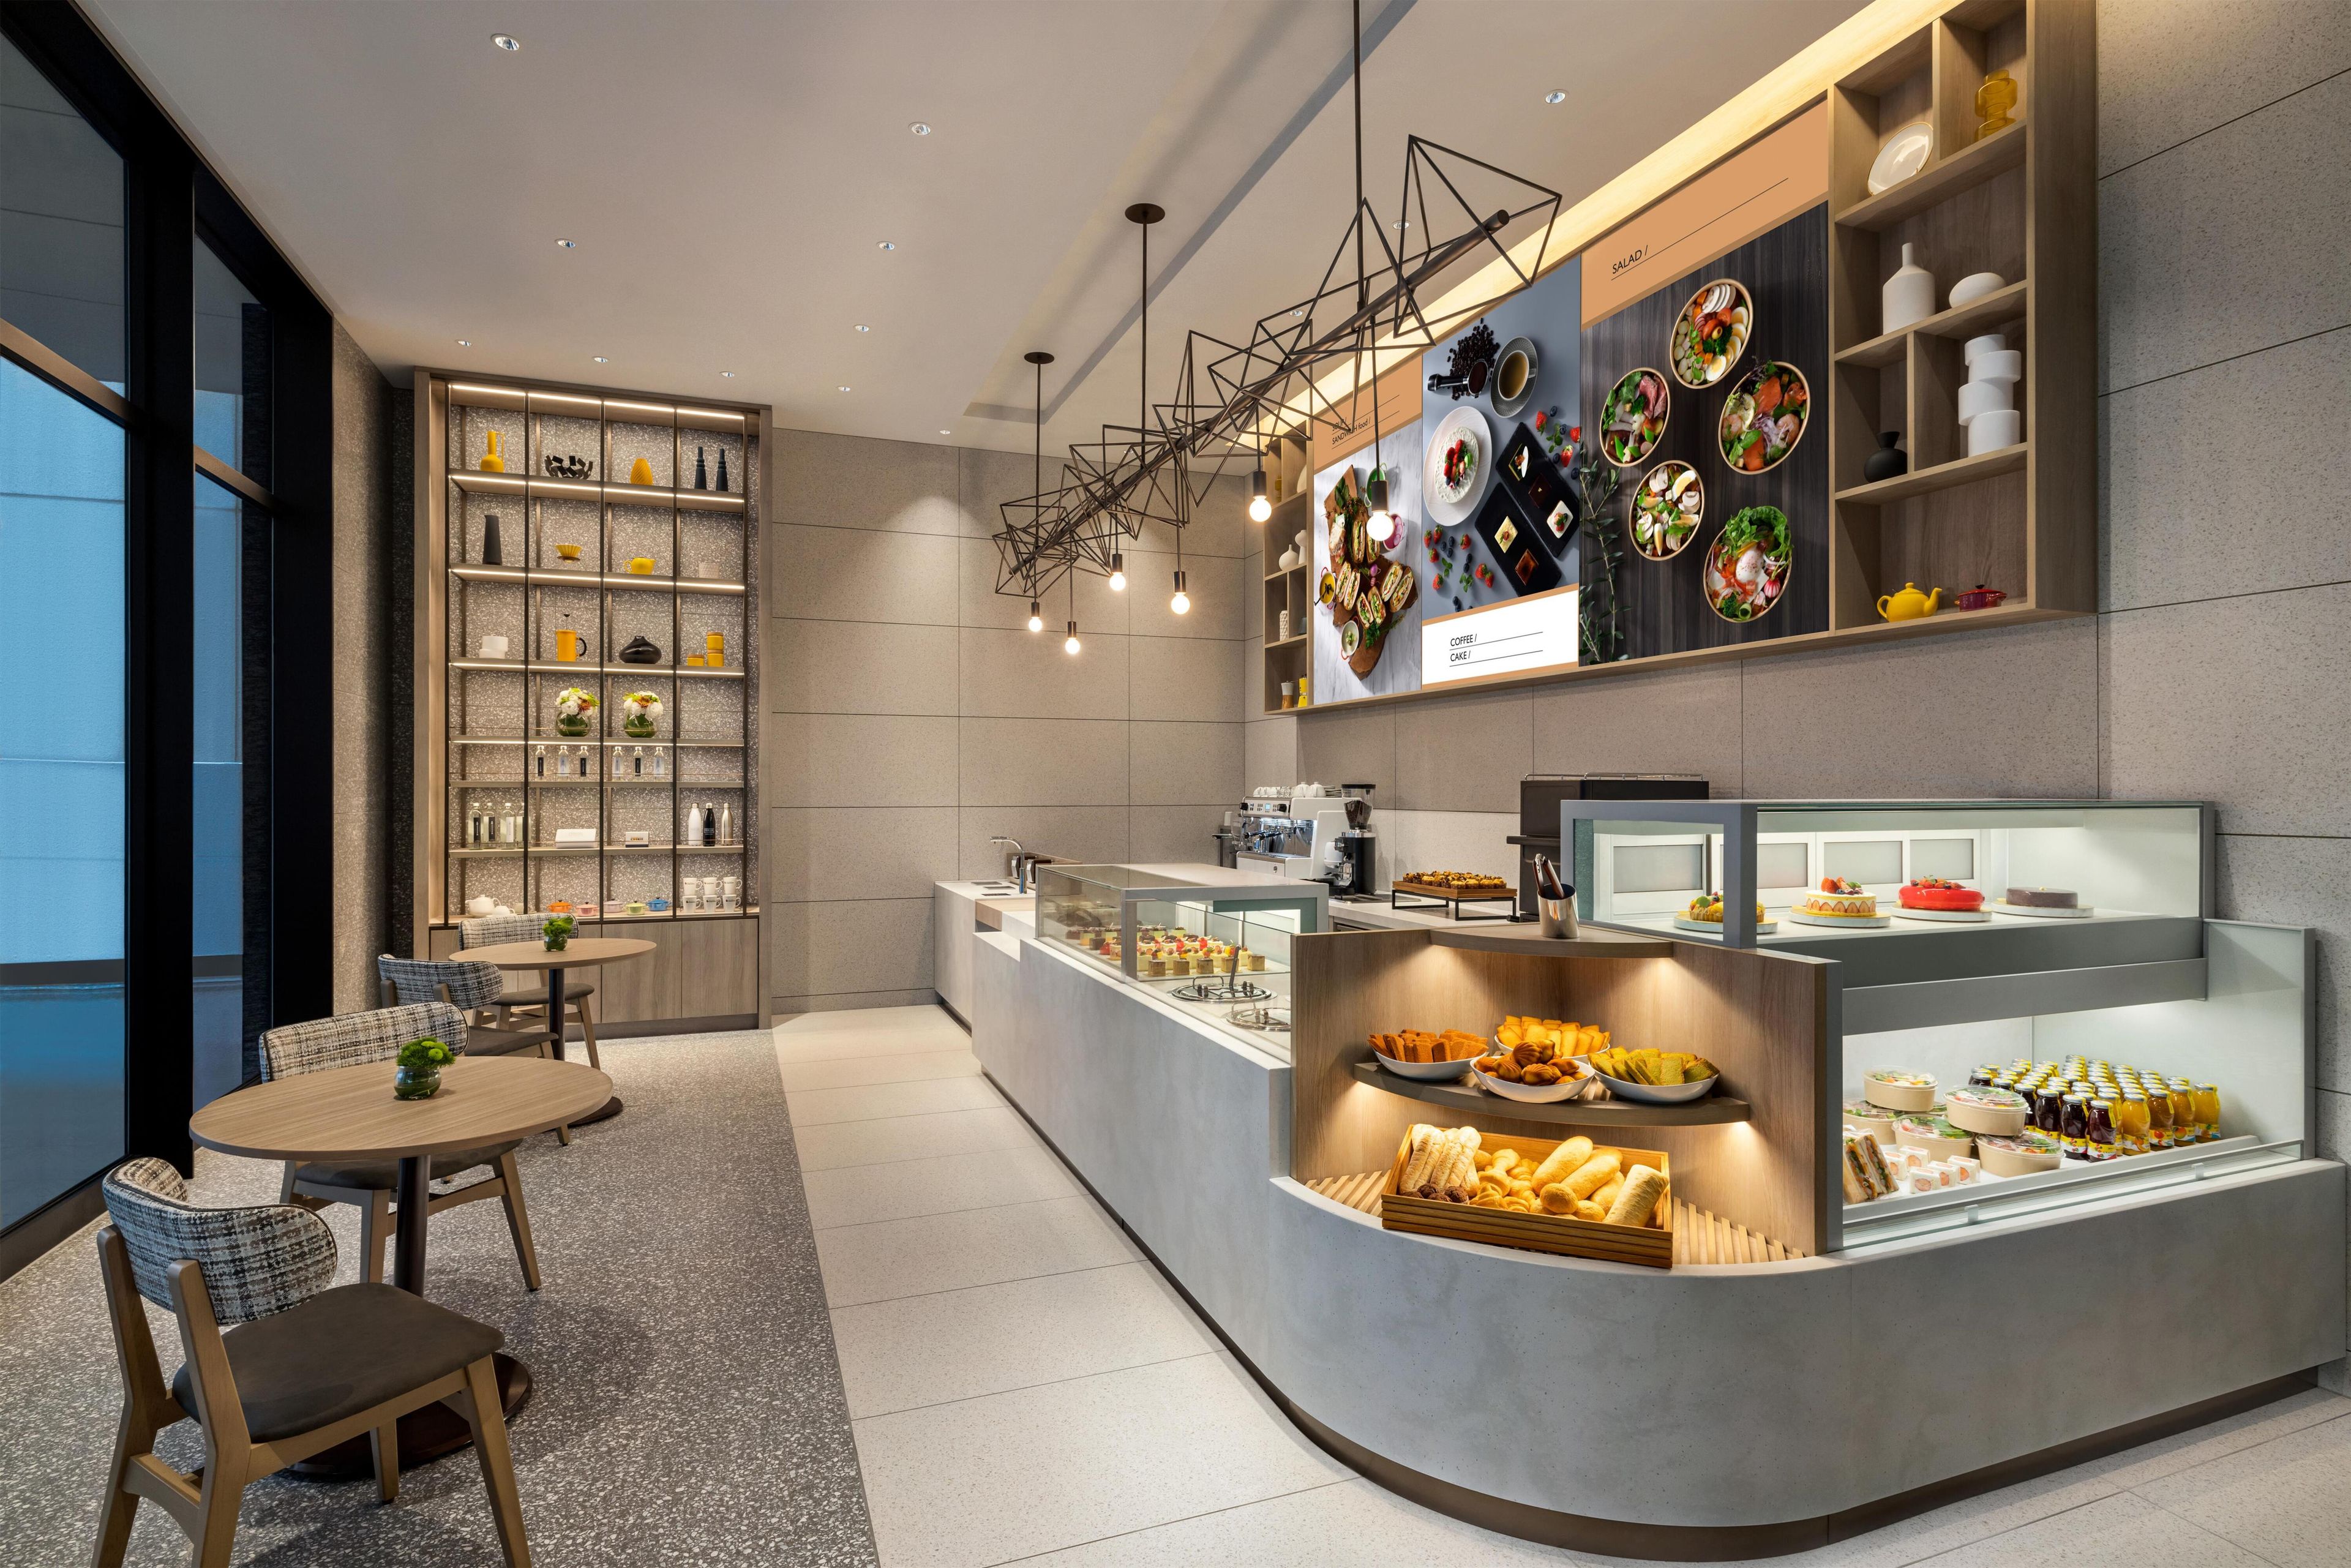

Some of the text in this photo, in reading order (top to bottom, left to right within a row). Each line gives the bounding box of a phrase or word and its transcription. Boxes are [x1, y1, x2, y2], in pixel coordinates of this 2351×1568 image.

[1612, 249, 1642, 274] SALAD
[1358, 418, 1368, 430] food
[1450, 634, 1473, 647] COFFEE
[1450, 651, 1467, 662] CAKE
